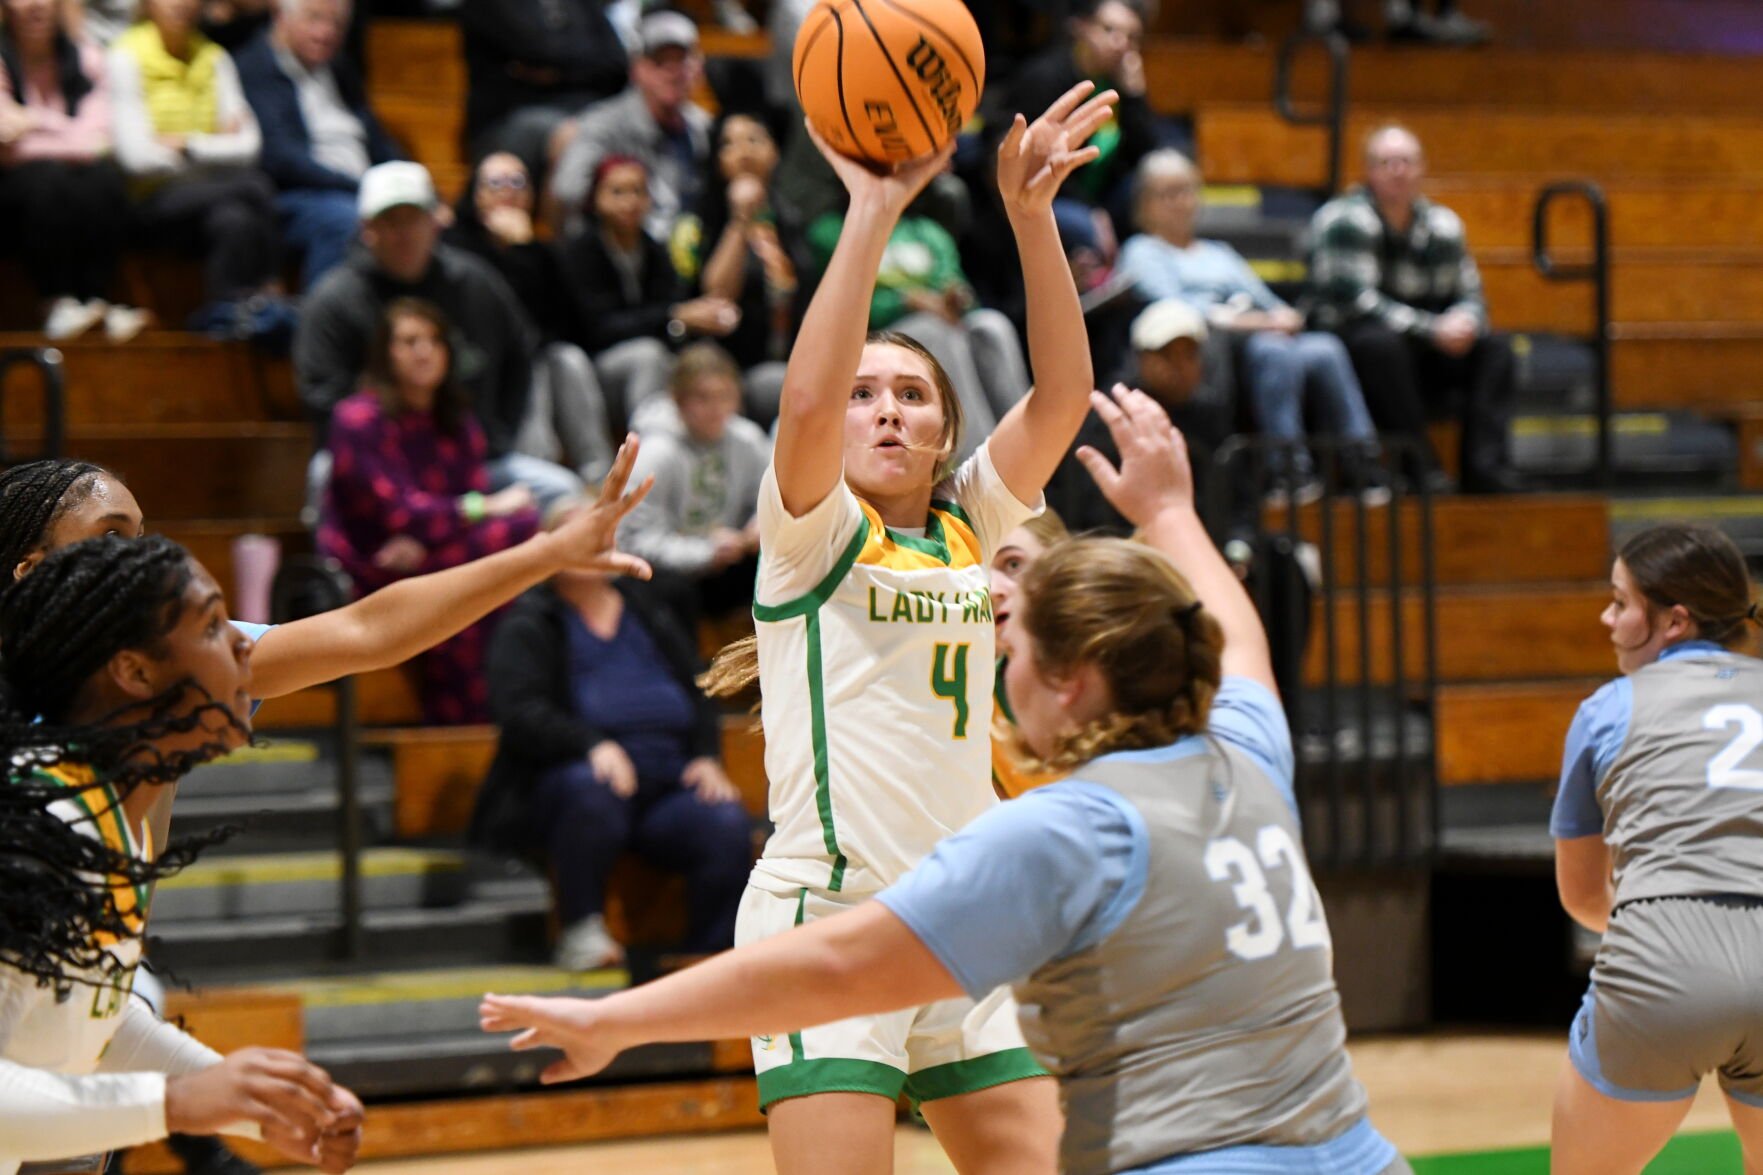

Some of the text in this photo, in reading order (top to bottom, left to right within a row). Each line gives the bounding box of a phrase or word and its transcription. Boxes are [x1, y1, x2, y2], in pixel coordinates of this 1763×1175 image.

[906, 33, 962, 140] Wilso
[868, 584, 948, 624] LADY
[930, 641, 971, 741] 4
[1203, 823, 1332, 961] 32
